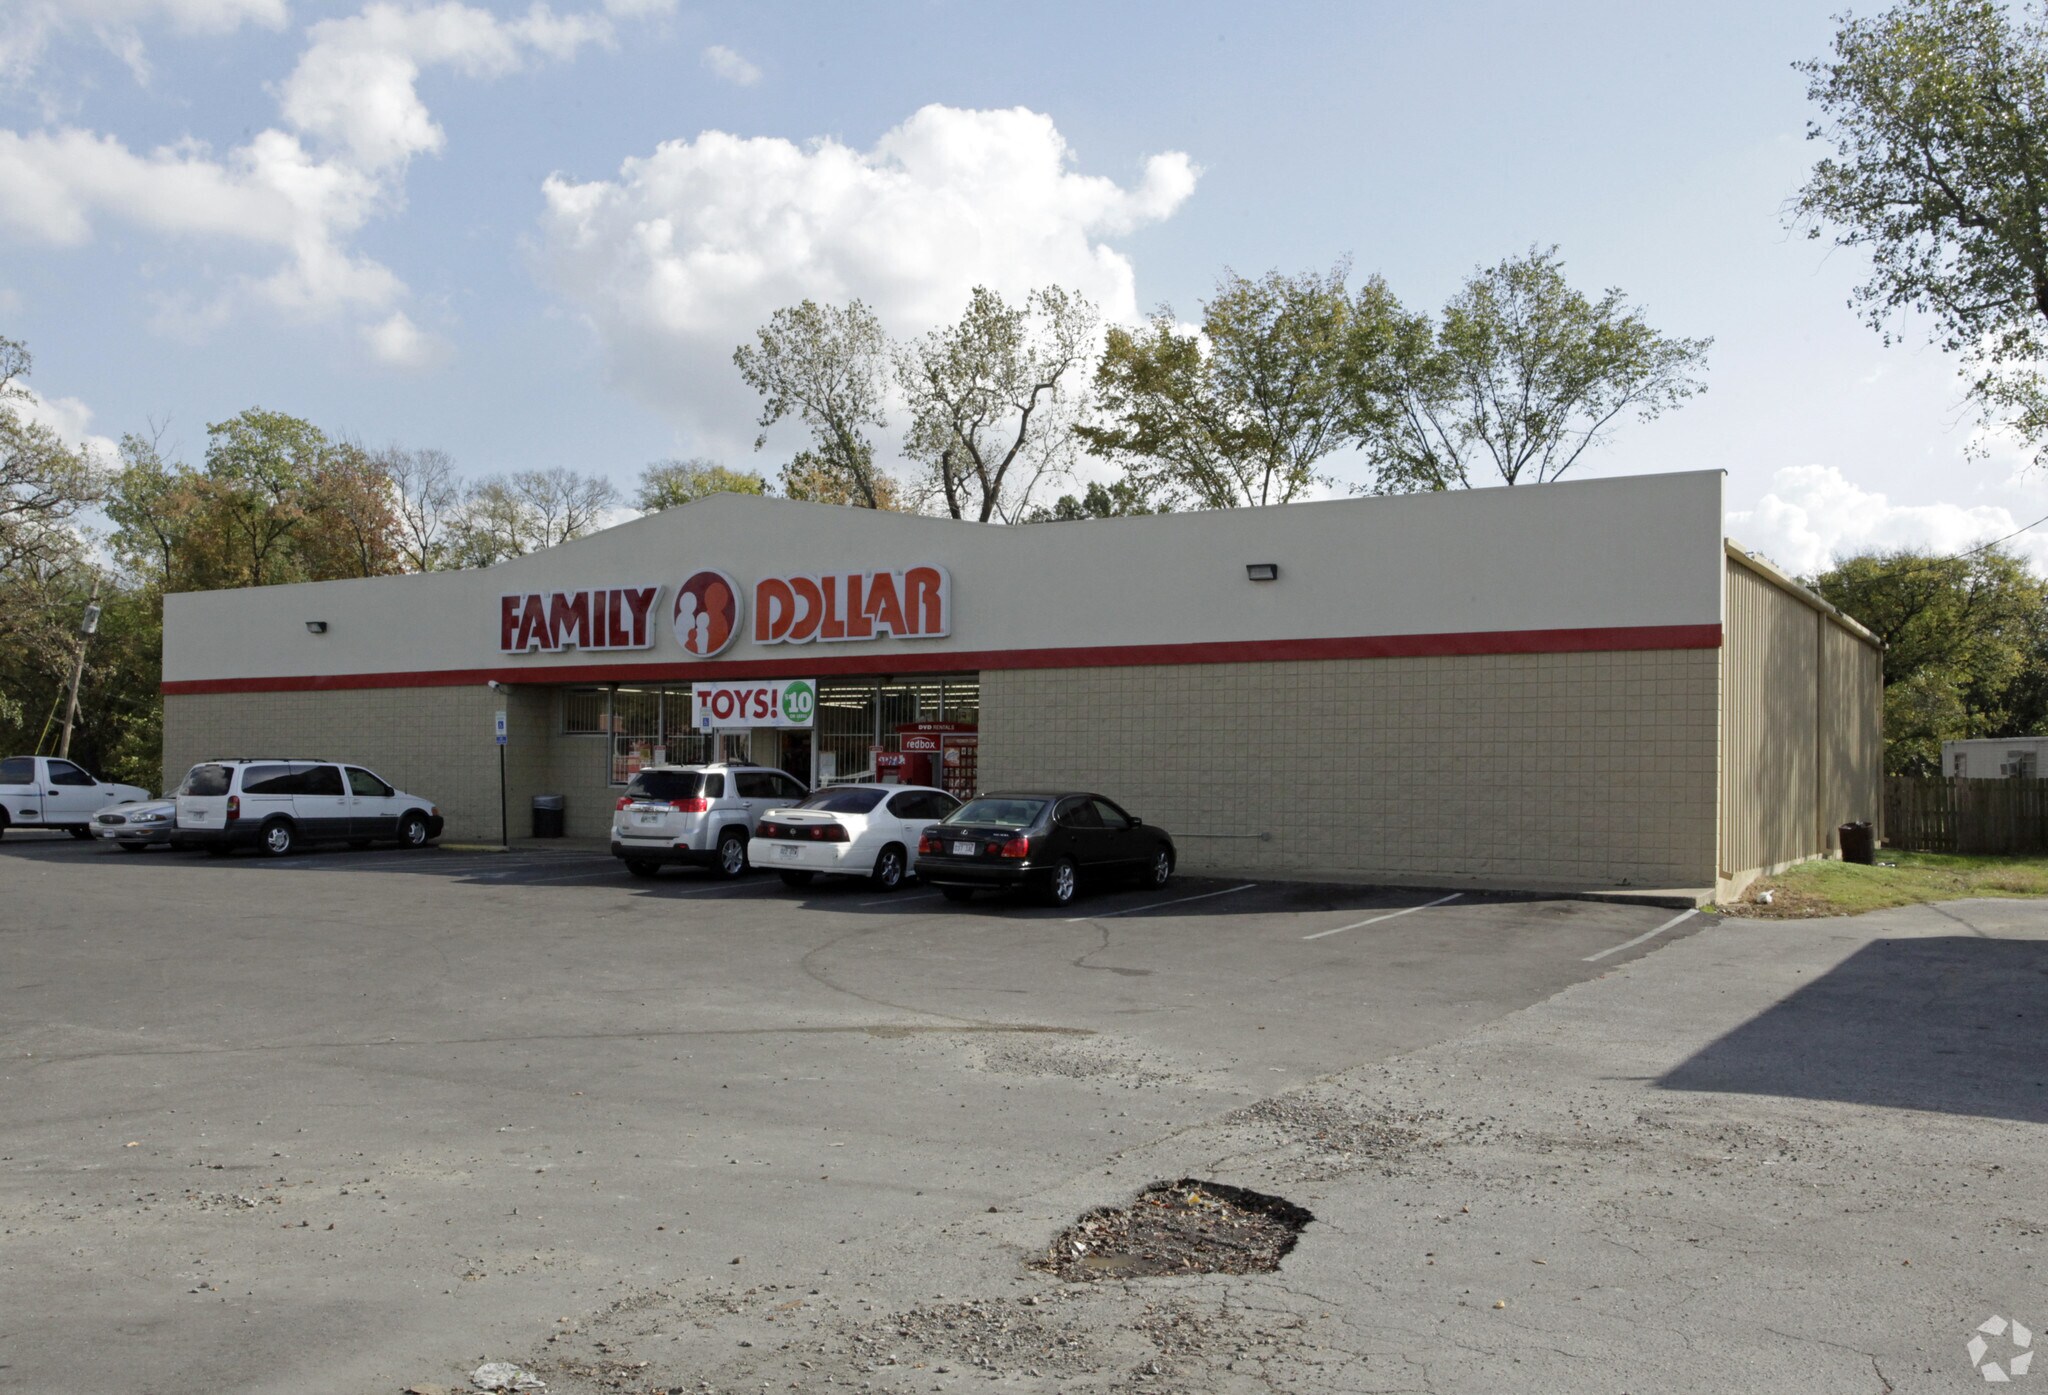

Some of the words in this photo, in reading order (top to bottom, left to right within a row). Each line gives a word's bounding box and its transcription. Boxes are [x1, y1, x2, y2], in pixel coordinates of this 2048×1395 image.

[500, 587, 657, 650] FAMILY
[756, 566, 942, 641] DOLLAR
[697, 688, 778, 719] TOYS!
[906, 738, 936, 749] redbox
